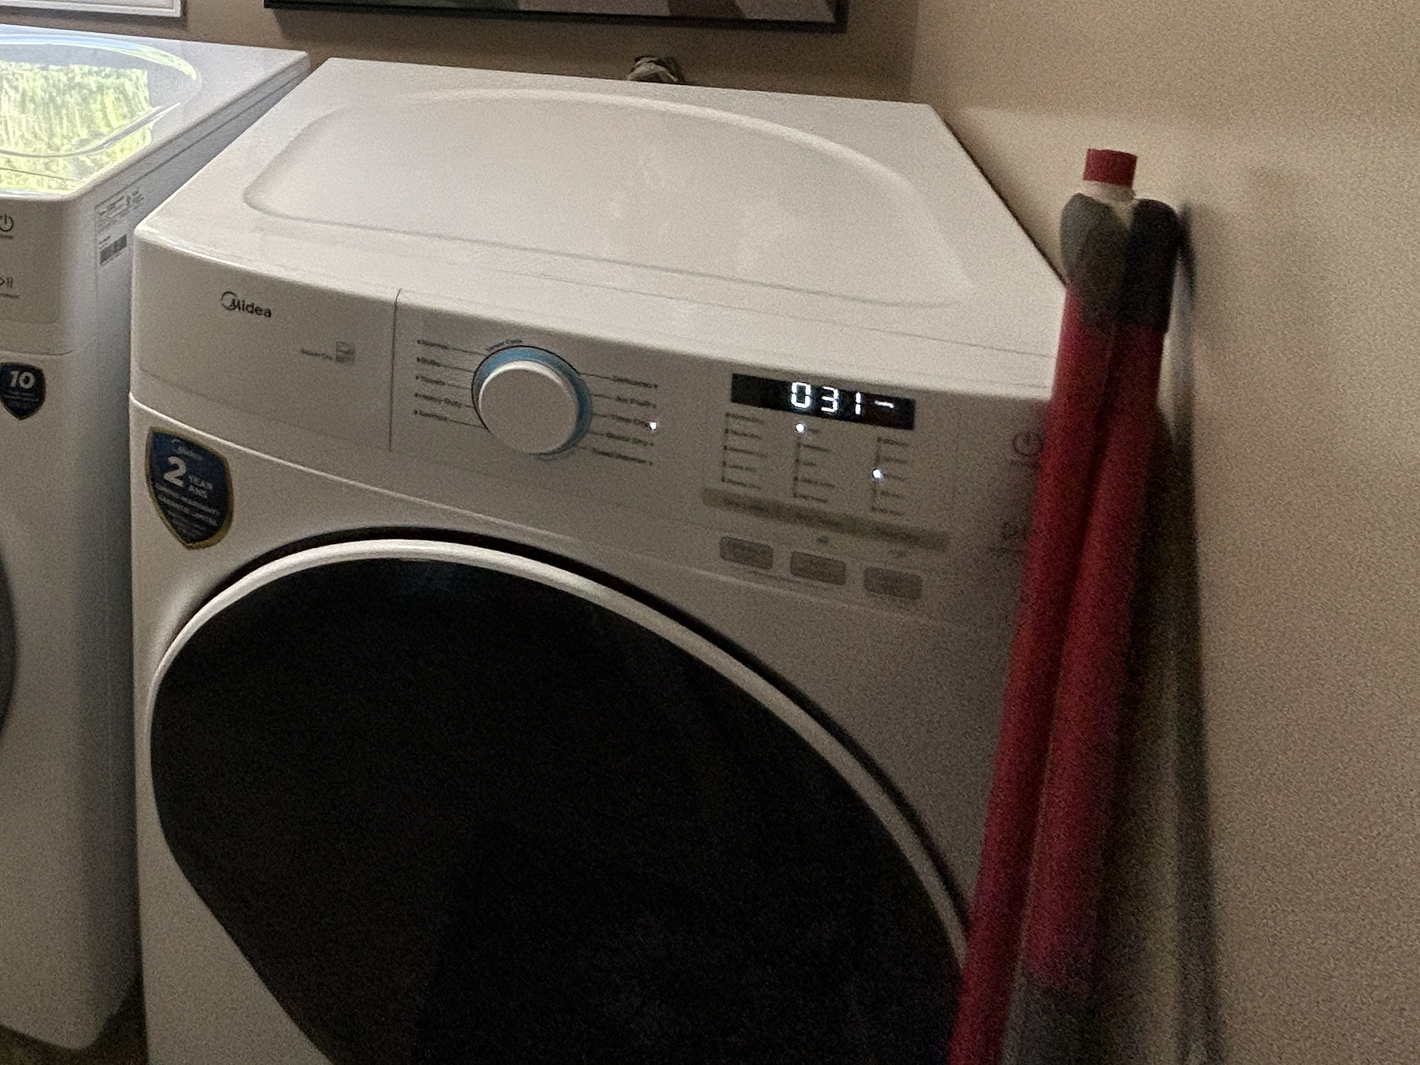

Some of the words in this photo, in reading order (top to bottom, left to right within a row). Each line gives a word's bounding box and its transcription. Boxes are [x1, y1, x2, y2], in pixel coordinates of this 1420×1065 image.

[221, 291, 272, 318] Midea
[9, 370, 36, 390] 10
[163, 456, 187, 488] 2
